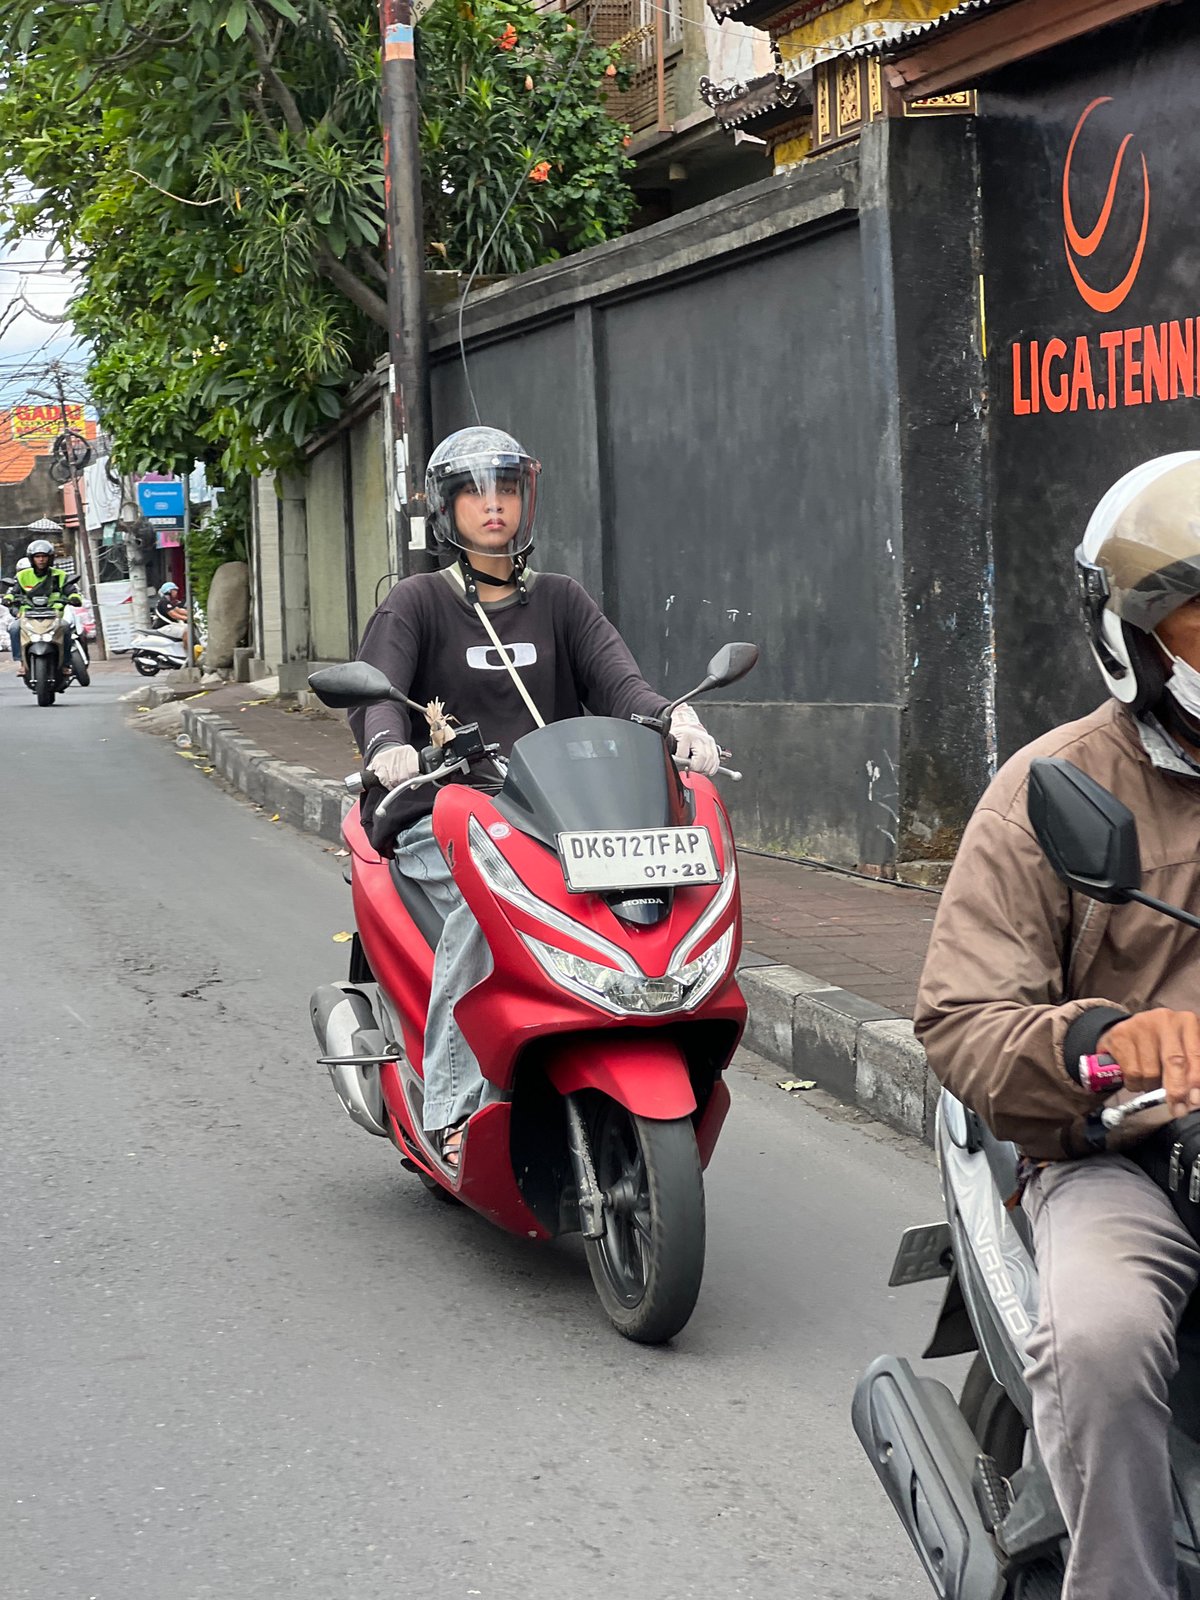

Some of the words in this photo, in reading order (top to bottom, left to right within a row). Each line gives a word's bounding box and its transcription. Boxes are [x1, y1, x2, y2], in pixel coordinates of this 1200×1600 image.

[571, 833, 699, 859] DK6727FAP
[622, 897, 665, 907] HONDA
[976, 1217, 1032, 1335] VARIO
